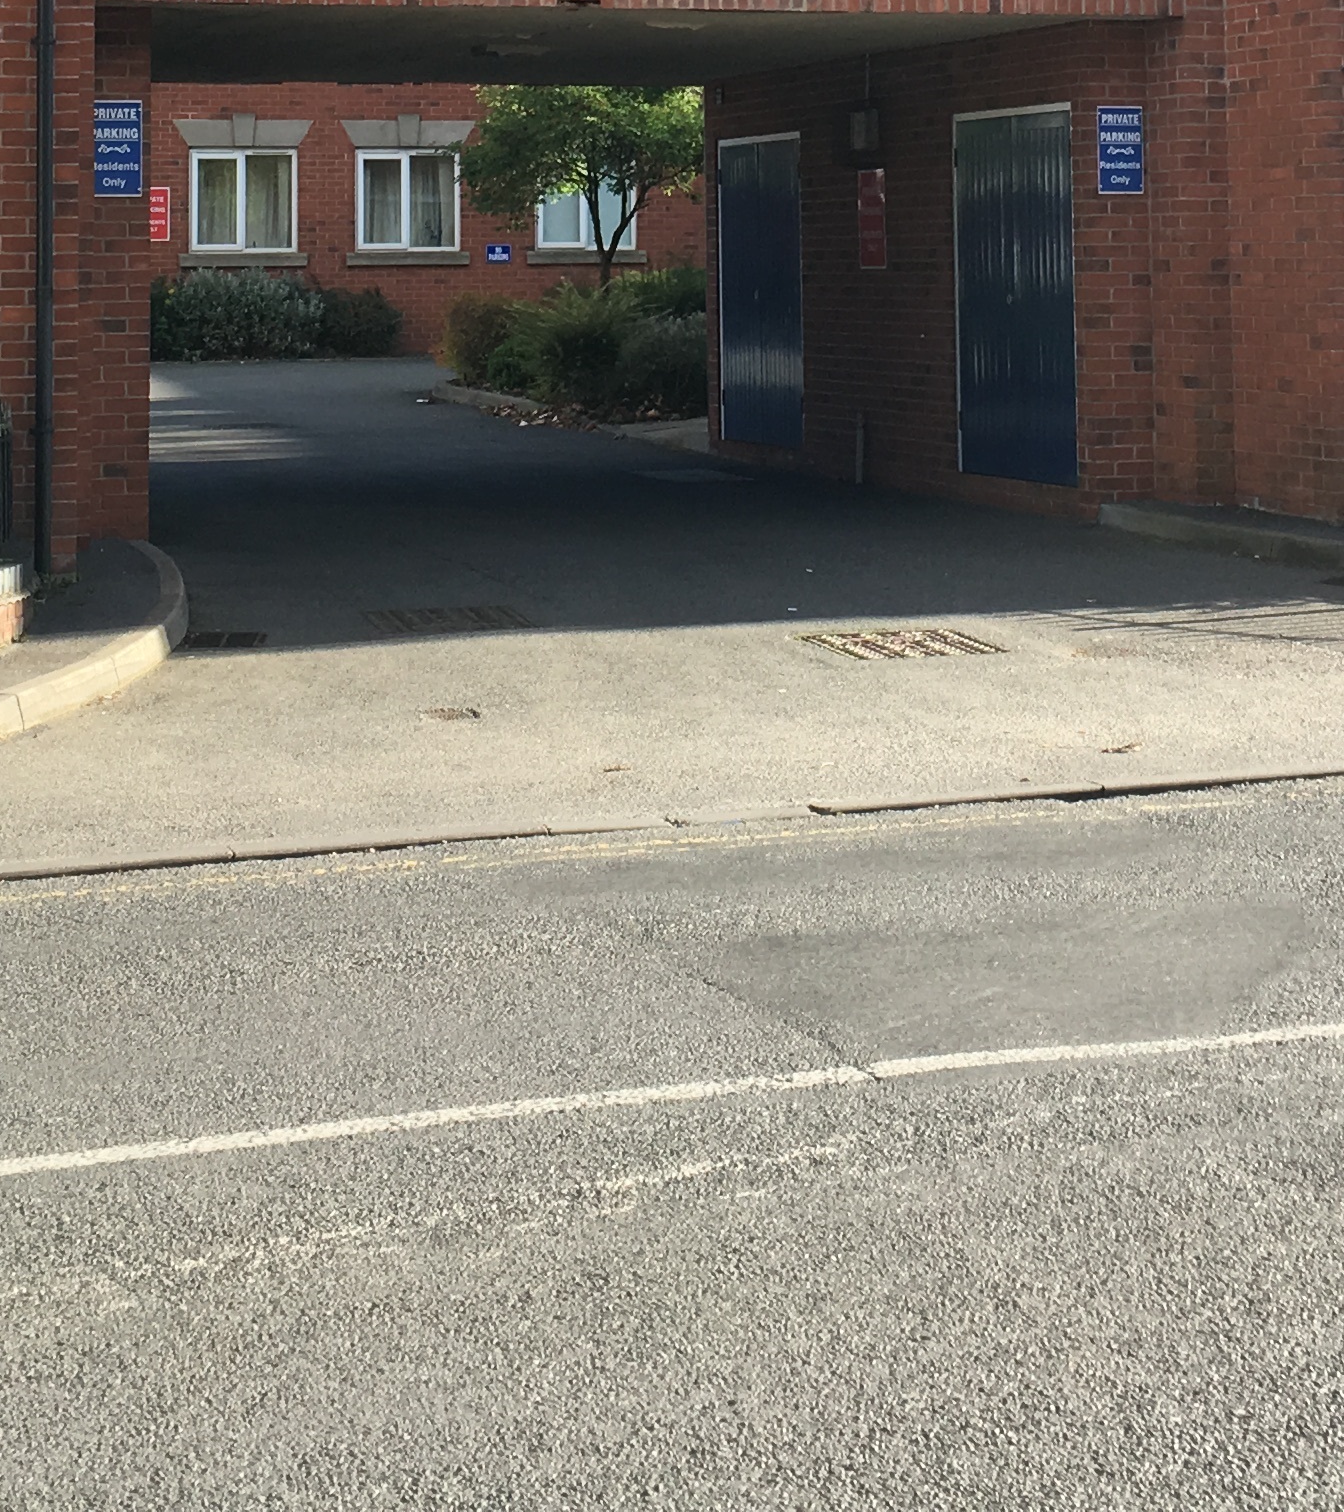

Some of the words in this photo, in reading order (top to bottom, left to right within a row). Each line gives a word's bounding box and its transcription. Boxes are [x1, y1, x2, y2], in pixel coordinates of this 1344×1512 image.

[1101, 114, 1139, 125] PRIVATE
[1100, 131, 1141, 142] PARKING
[1100, 161, 1141, 170] Residents
[102, 177, 126, 189] Only
[1110, 175, 1130, 186] Only
